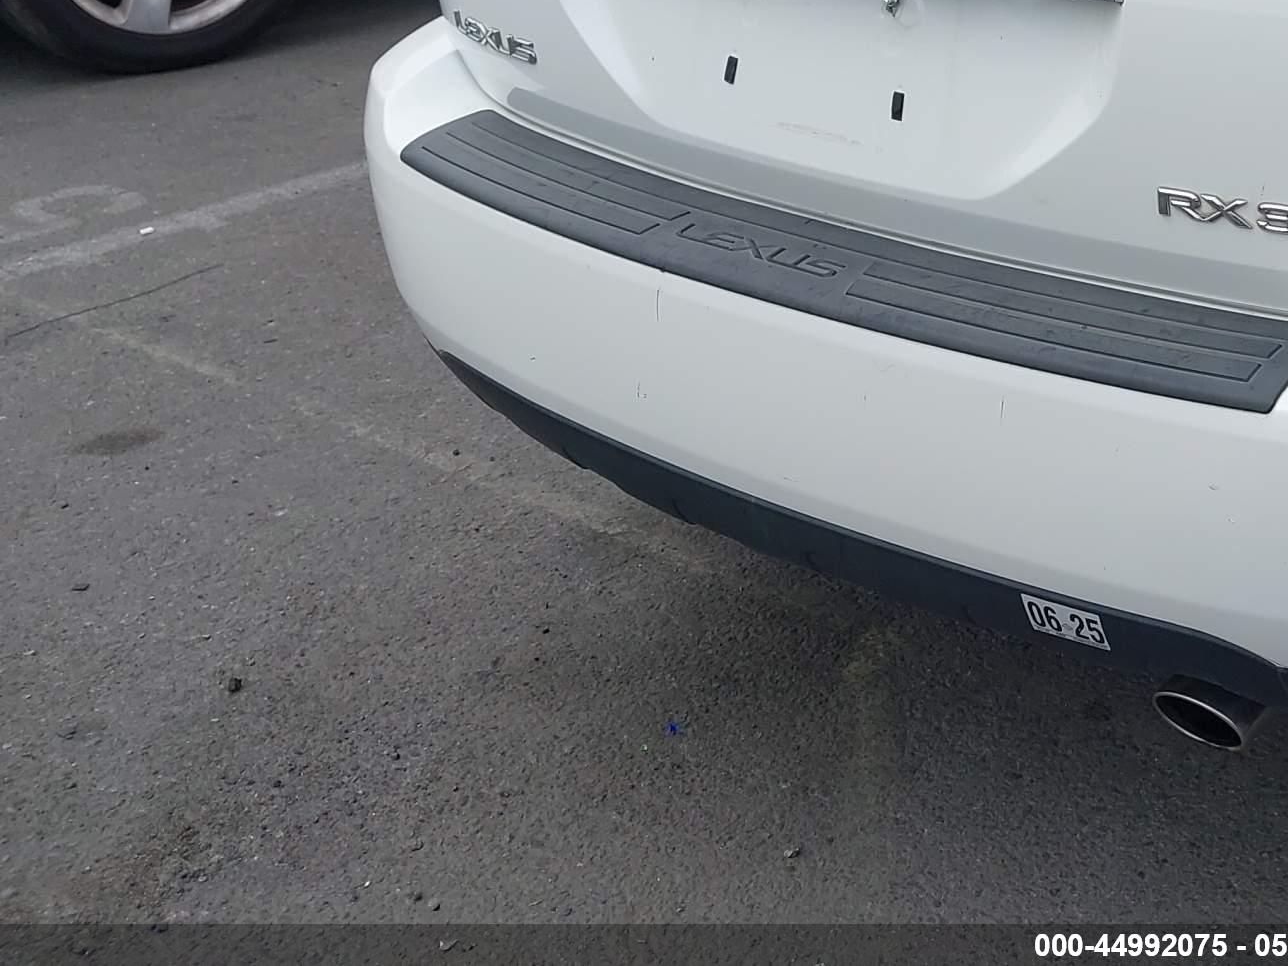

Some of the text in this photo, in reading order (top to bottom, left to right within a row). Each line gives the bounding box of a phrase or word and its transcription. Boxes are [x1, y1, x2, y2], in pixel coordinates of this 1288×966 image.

[453, 9, 537, 65] LEXUS
[1156, 186, 1253, 230] RX
[676, 222, 847, 279] LEXUS
[1027, 601, 1063, 632] 06
[1069, 614, 1106, 644] 25
